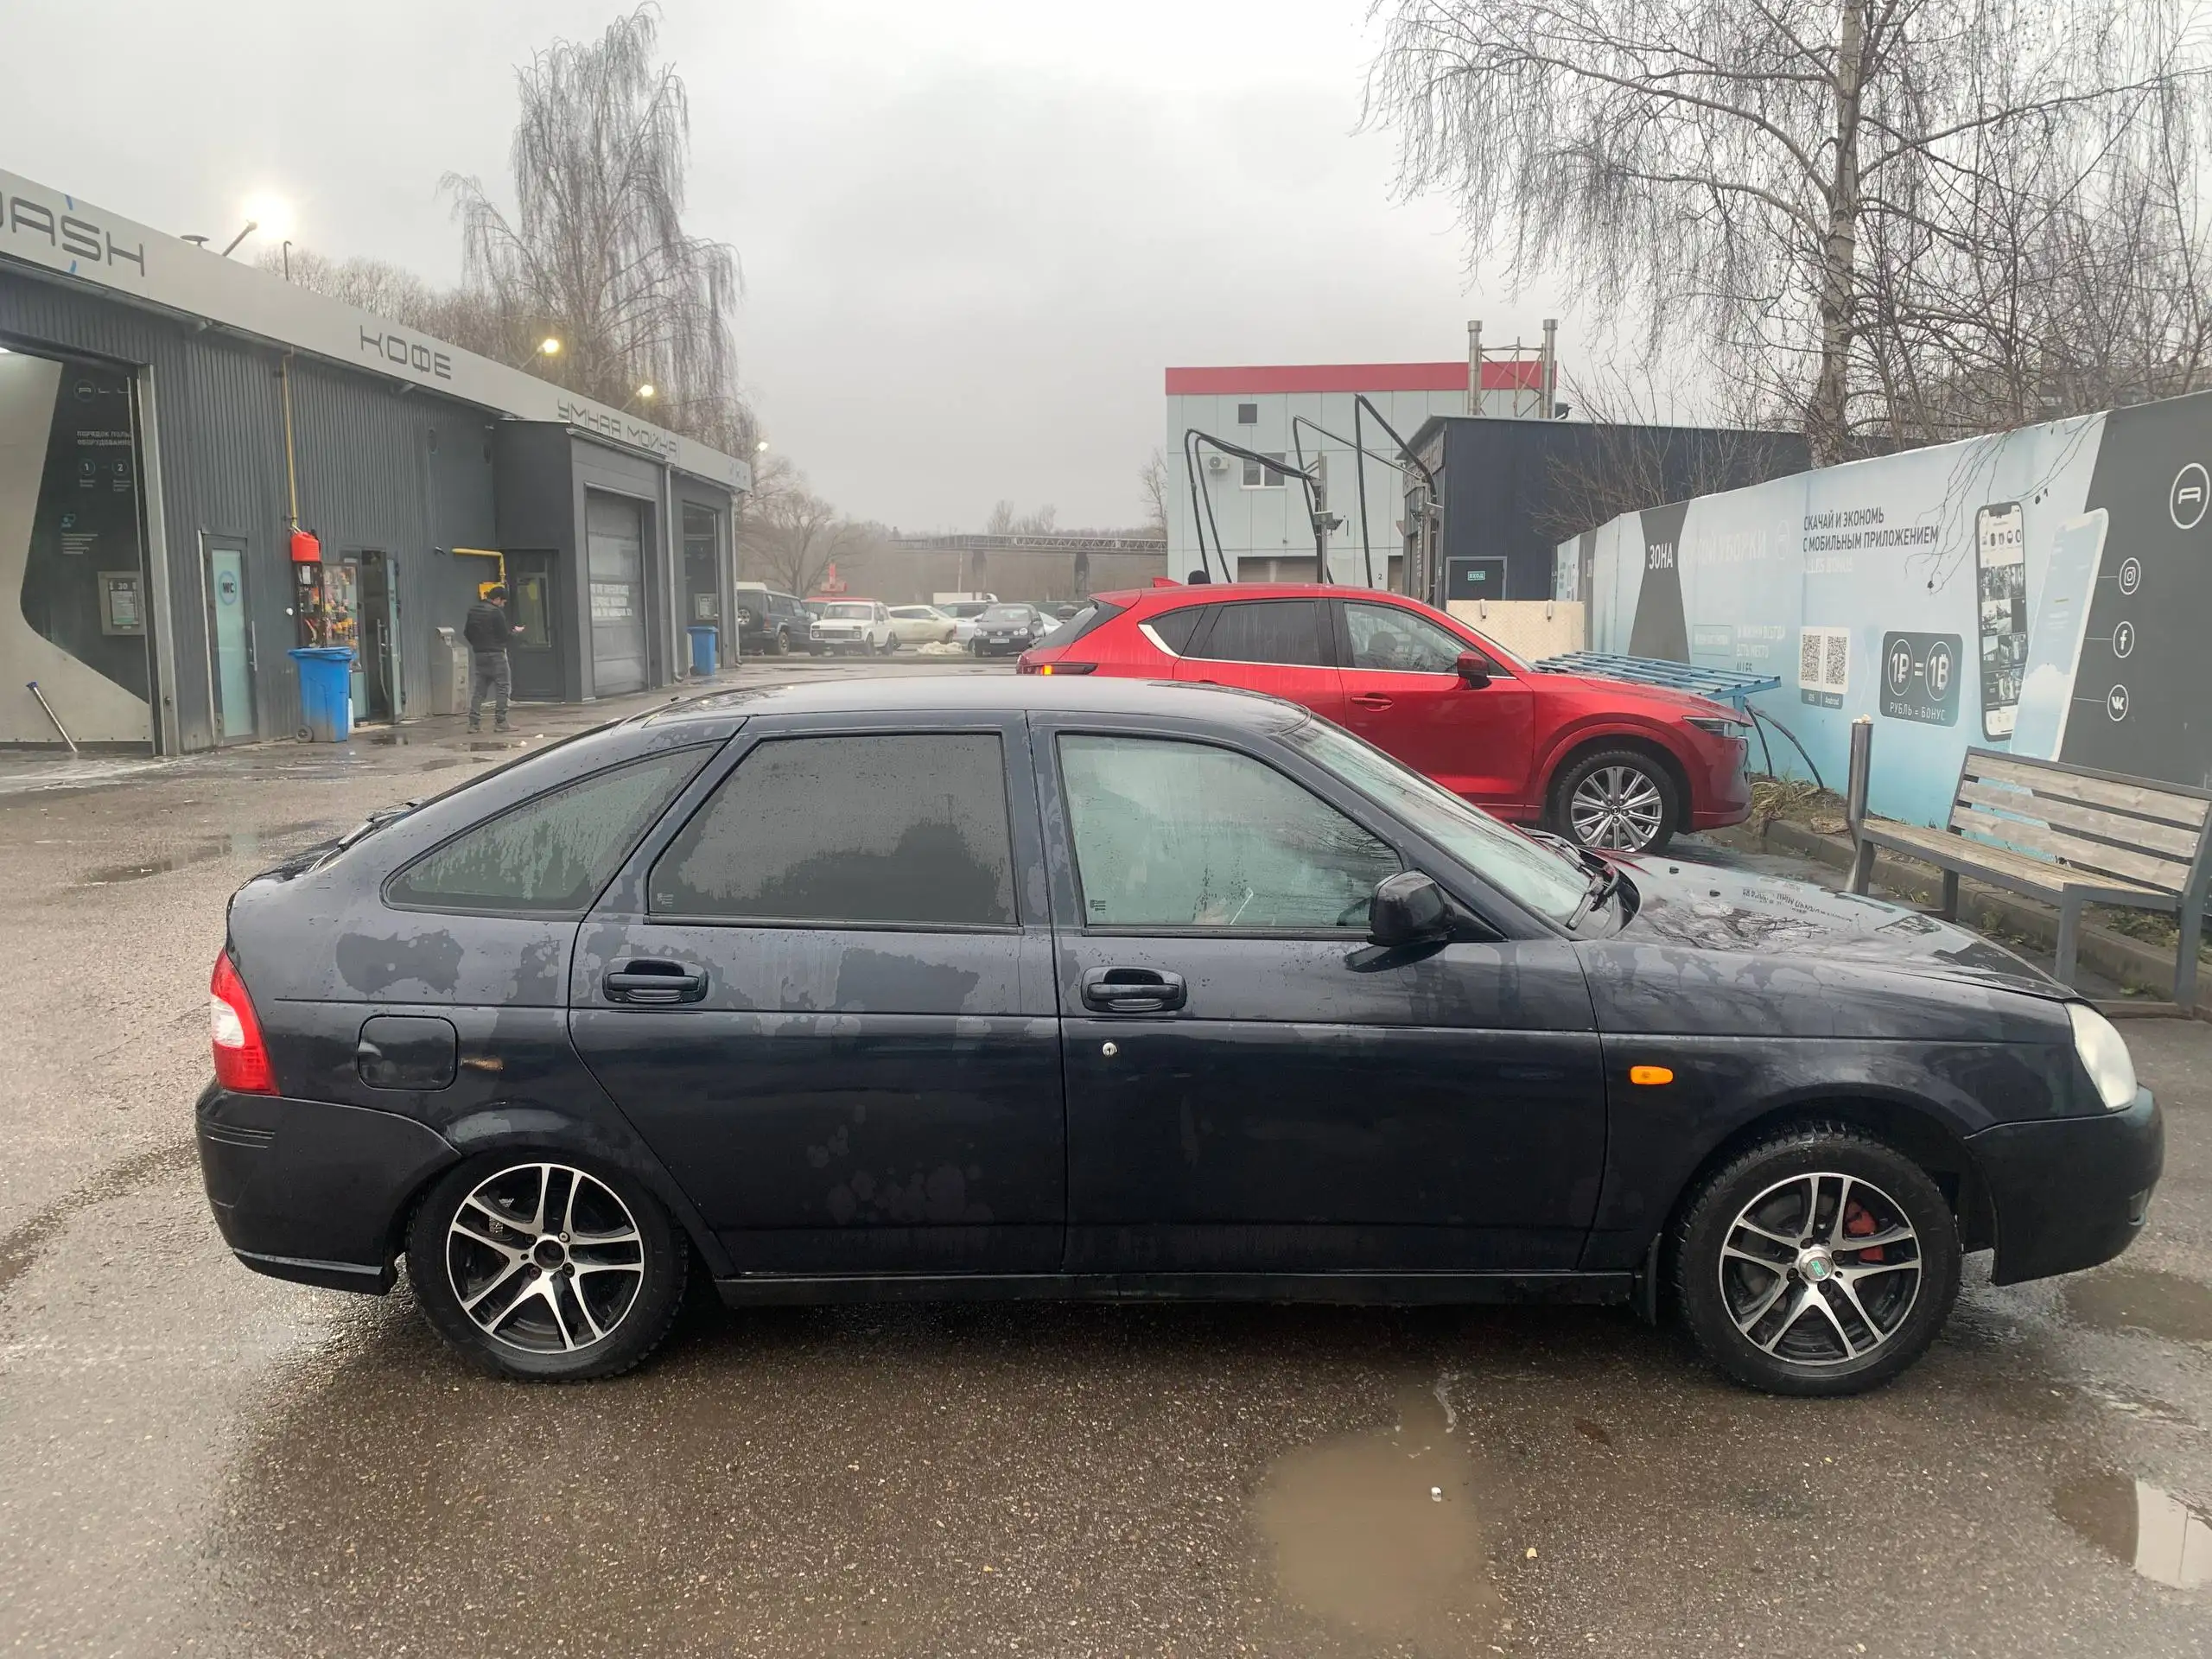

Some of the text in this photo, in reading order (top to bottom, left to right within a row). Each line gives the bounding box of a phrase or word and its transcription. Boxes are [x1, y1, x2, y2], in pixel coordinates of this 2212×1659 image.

[0, 190, 144, 276] ASH
[359, 324, 451, 380] КОФЕ
[1803, 506, 1885, 531] СКАЧАЙ И ЭКОНОМЬ
[1808, 532, 1862, 552] МОБИЛЬНЫМ
[1864, 525, 1939, 549] ПРИЛОЖЕНИЕМ
[1649, 542, 1674, 570] ЗОНА
[222, 582, 234, 594] WC
[1890, 702, 1912, 715] РУБЛЬ
[1921, 706, 1946, 721] БОНУС
